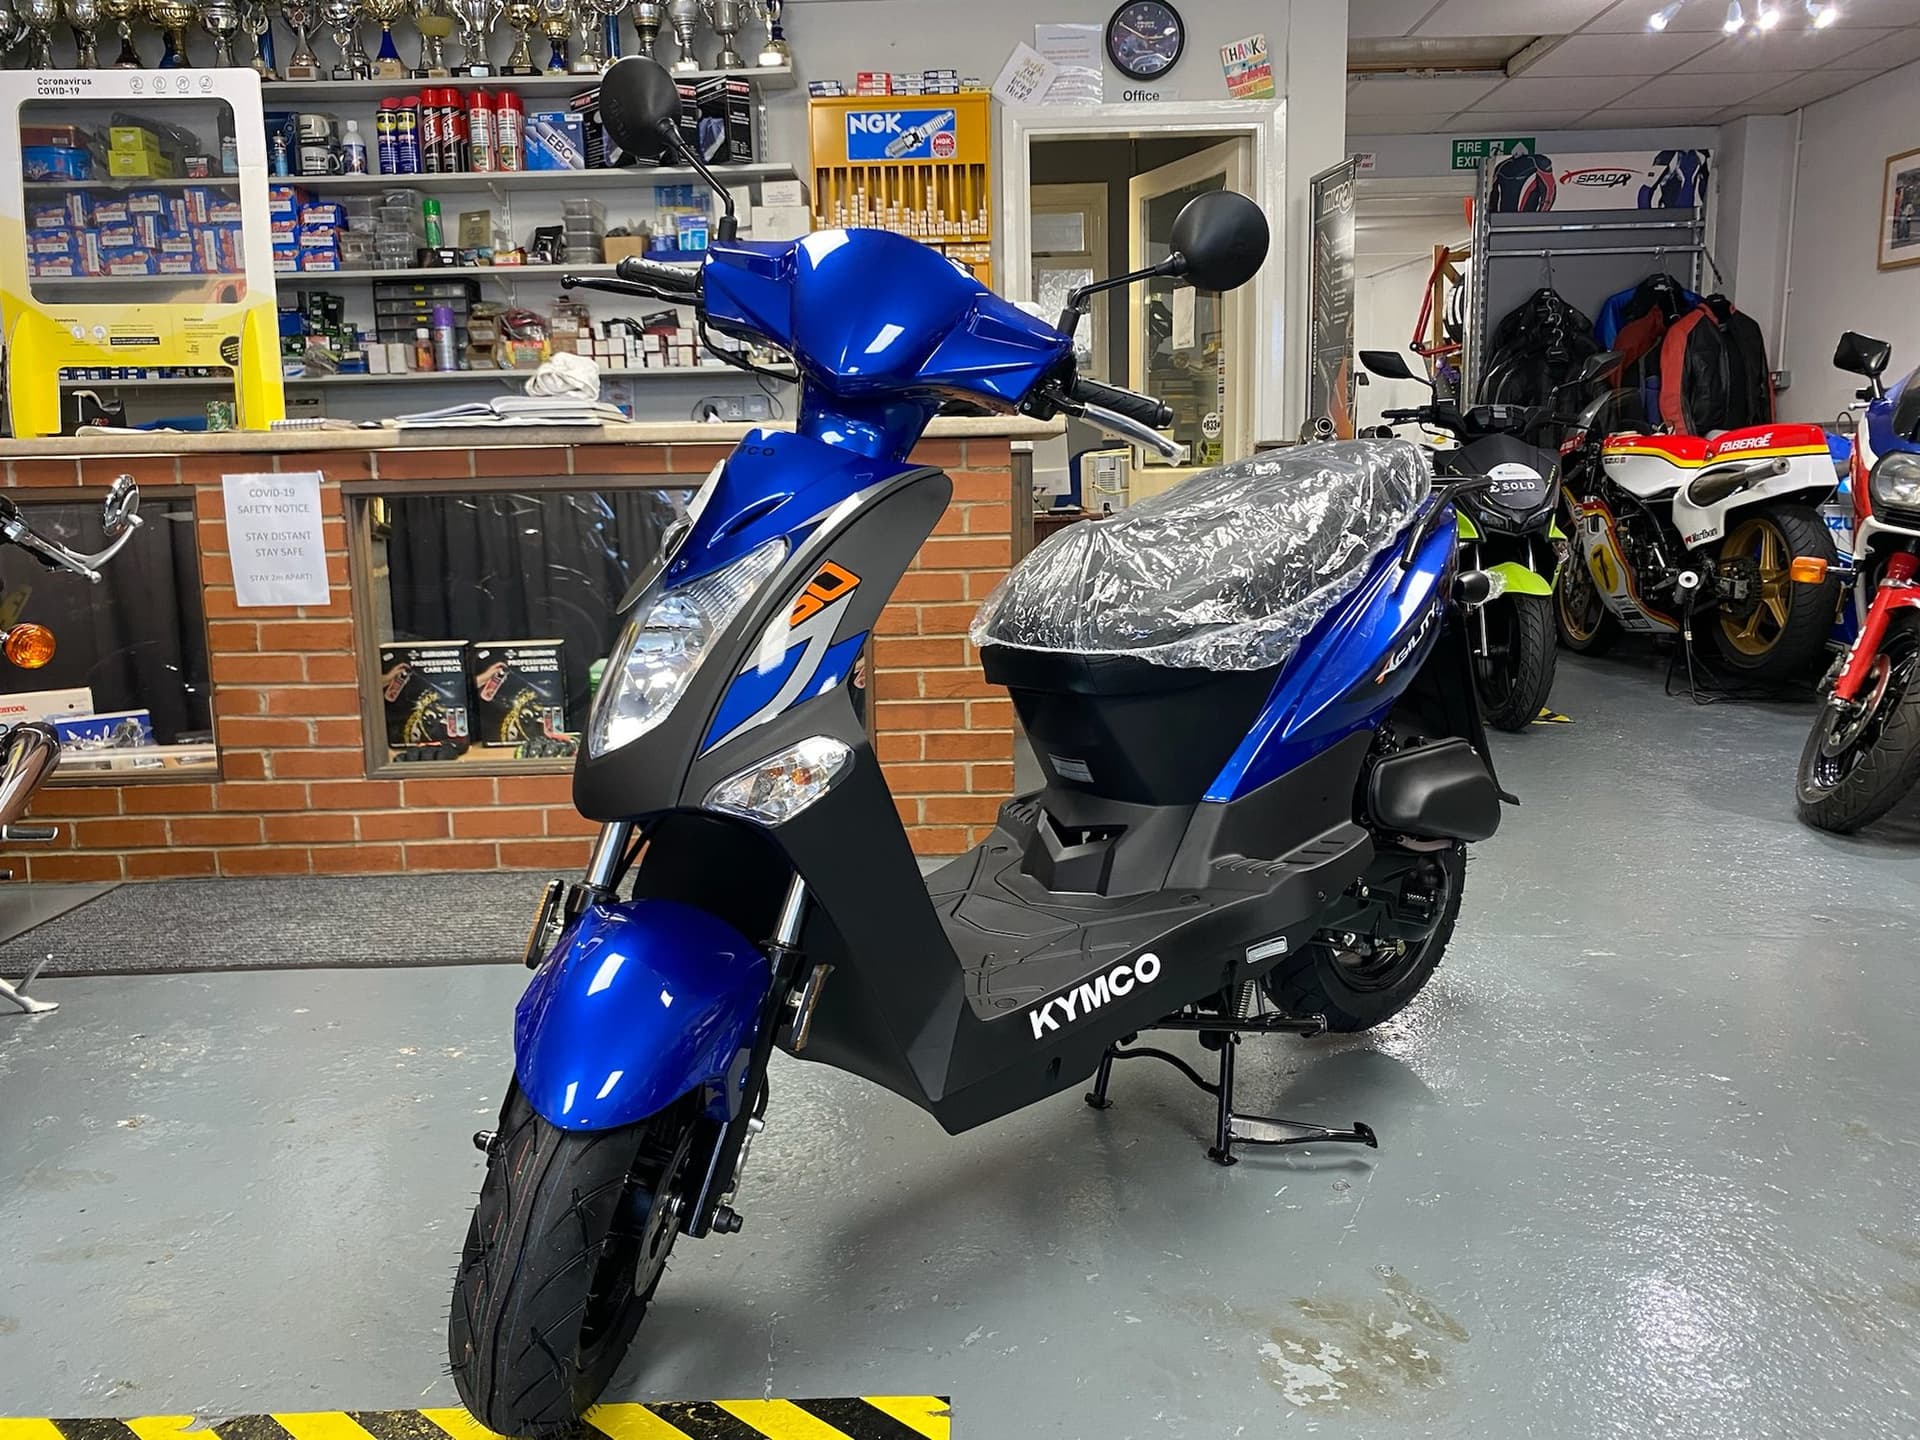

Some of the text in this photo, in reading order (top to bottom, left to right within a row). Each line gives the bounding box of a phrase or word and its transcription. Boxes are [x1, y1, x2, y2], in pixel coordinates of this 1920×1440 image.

[1220, 37, 1266, 64] THANKS
[37, 77, 92, 86] Coronavirus
[37, 87, 80, 95] COVID-19
[1123, 90, 1160, 101] Office
[850, 113, 902, 134] NGK
[546, 134, 573, 160] EBC
[1457, 142, 1482, 153] FIRE
[1577, 172, 1632, 188] SPADA
[1502, 482, 1536, 490] SOLD
[249, 488, 295, 498] COVID-19
[237, 504, 310, 514] SAFETY NOTICE
[245, 531, 311, 541] STAY DISTANT
[255, 547, 304, 557] STAY SAFE
[249, 572, 313, 582] STAY 2m APART!
[423, 665, 462, 674] CARE PACK
[520, 664, 559, 673] CARE PACK
[1029, 952, 1161, 1040] KYMCO
